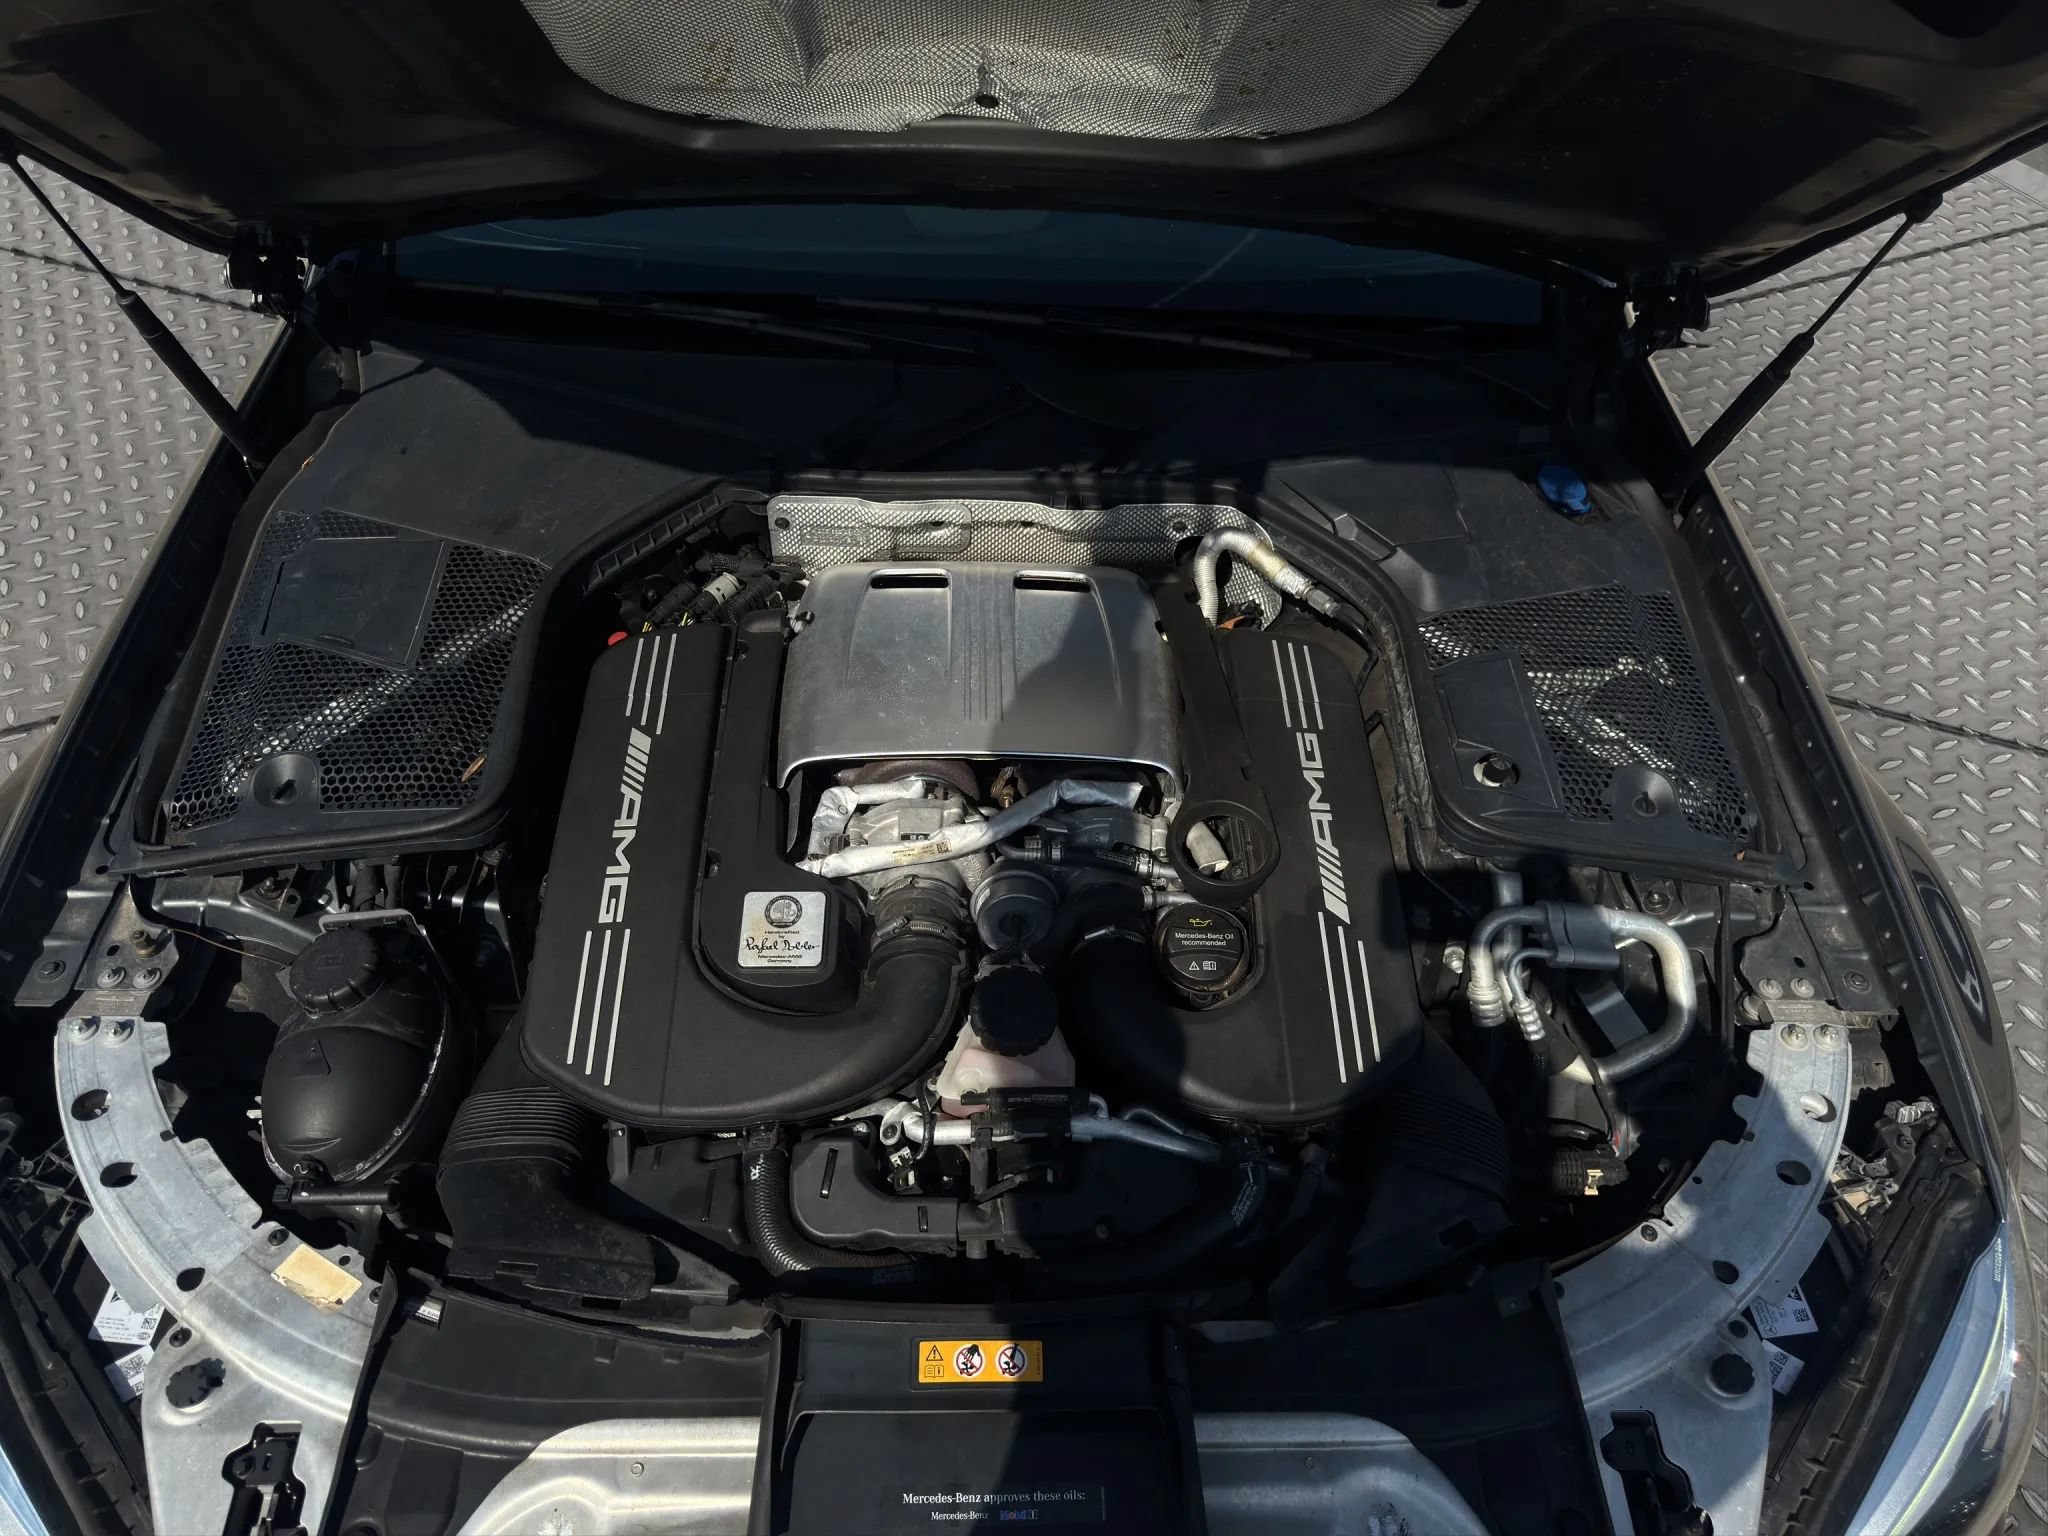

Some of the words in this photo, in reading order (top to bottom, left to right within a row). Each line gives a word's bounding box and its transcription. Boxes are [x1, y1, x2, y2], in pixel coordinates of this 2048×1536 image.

[1175, 932, 1224, 940] Mercedes-Benz
[902, 1492, 981, 1504] Mercedes-Benz
[983, 1493, 1030, 1504] approves
[1033, 1490, 1061, 1502] these
[1063, 1489, 1087, 1501] oils:
[931, 1510, 989, 1520] Mercedes-Benz
